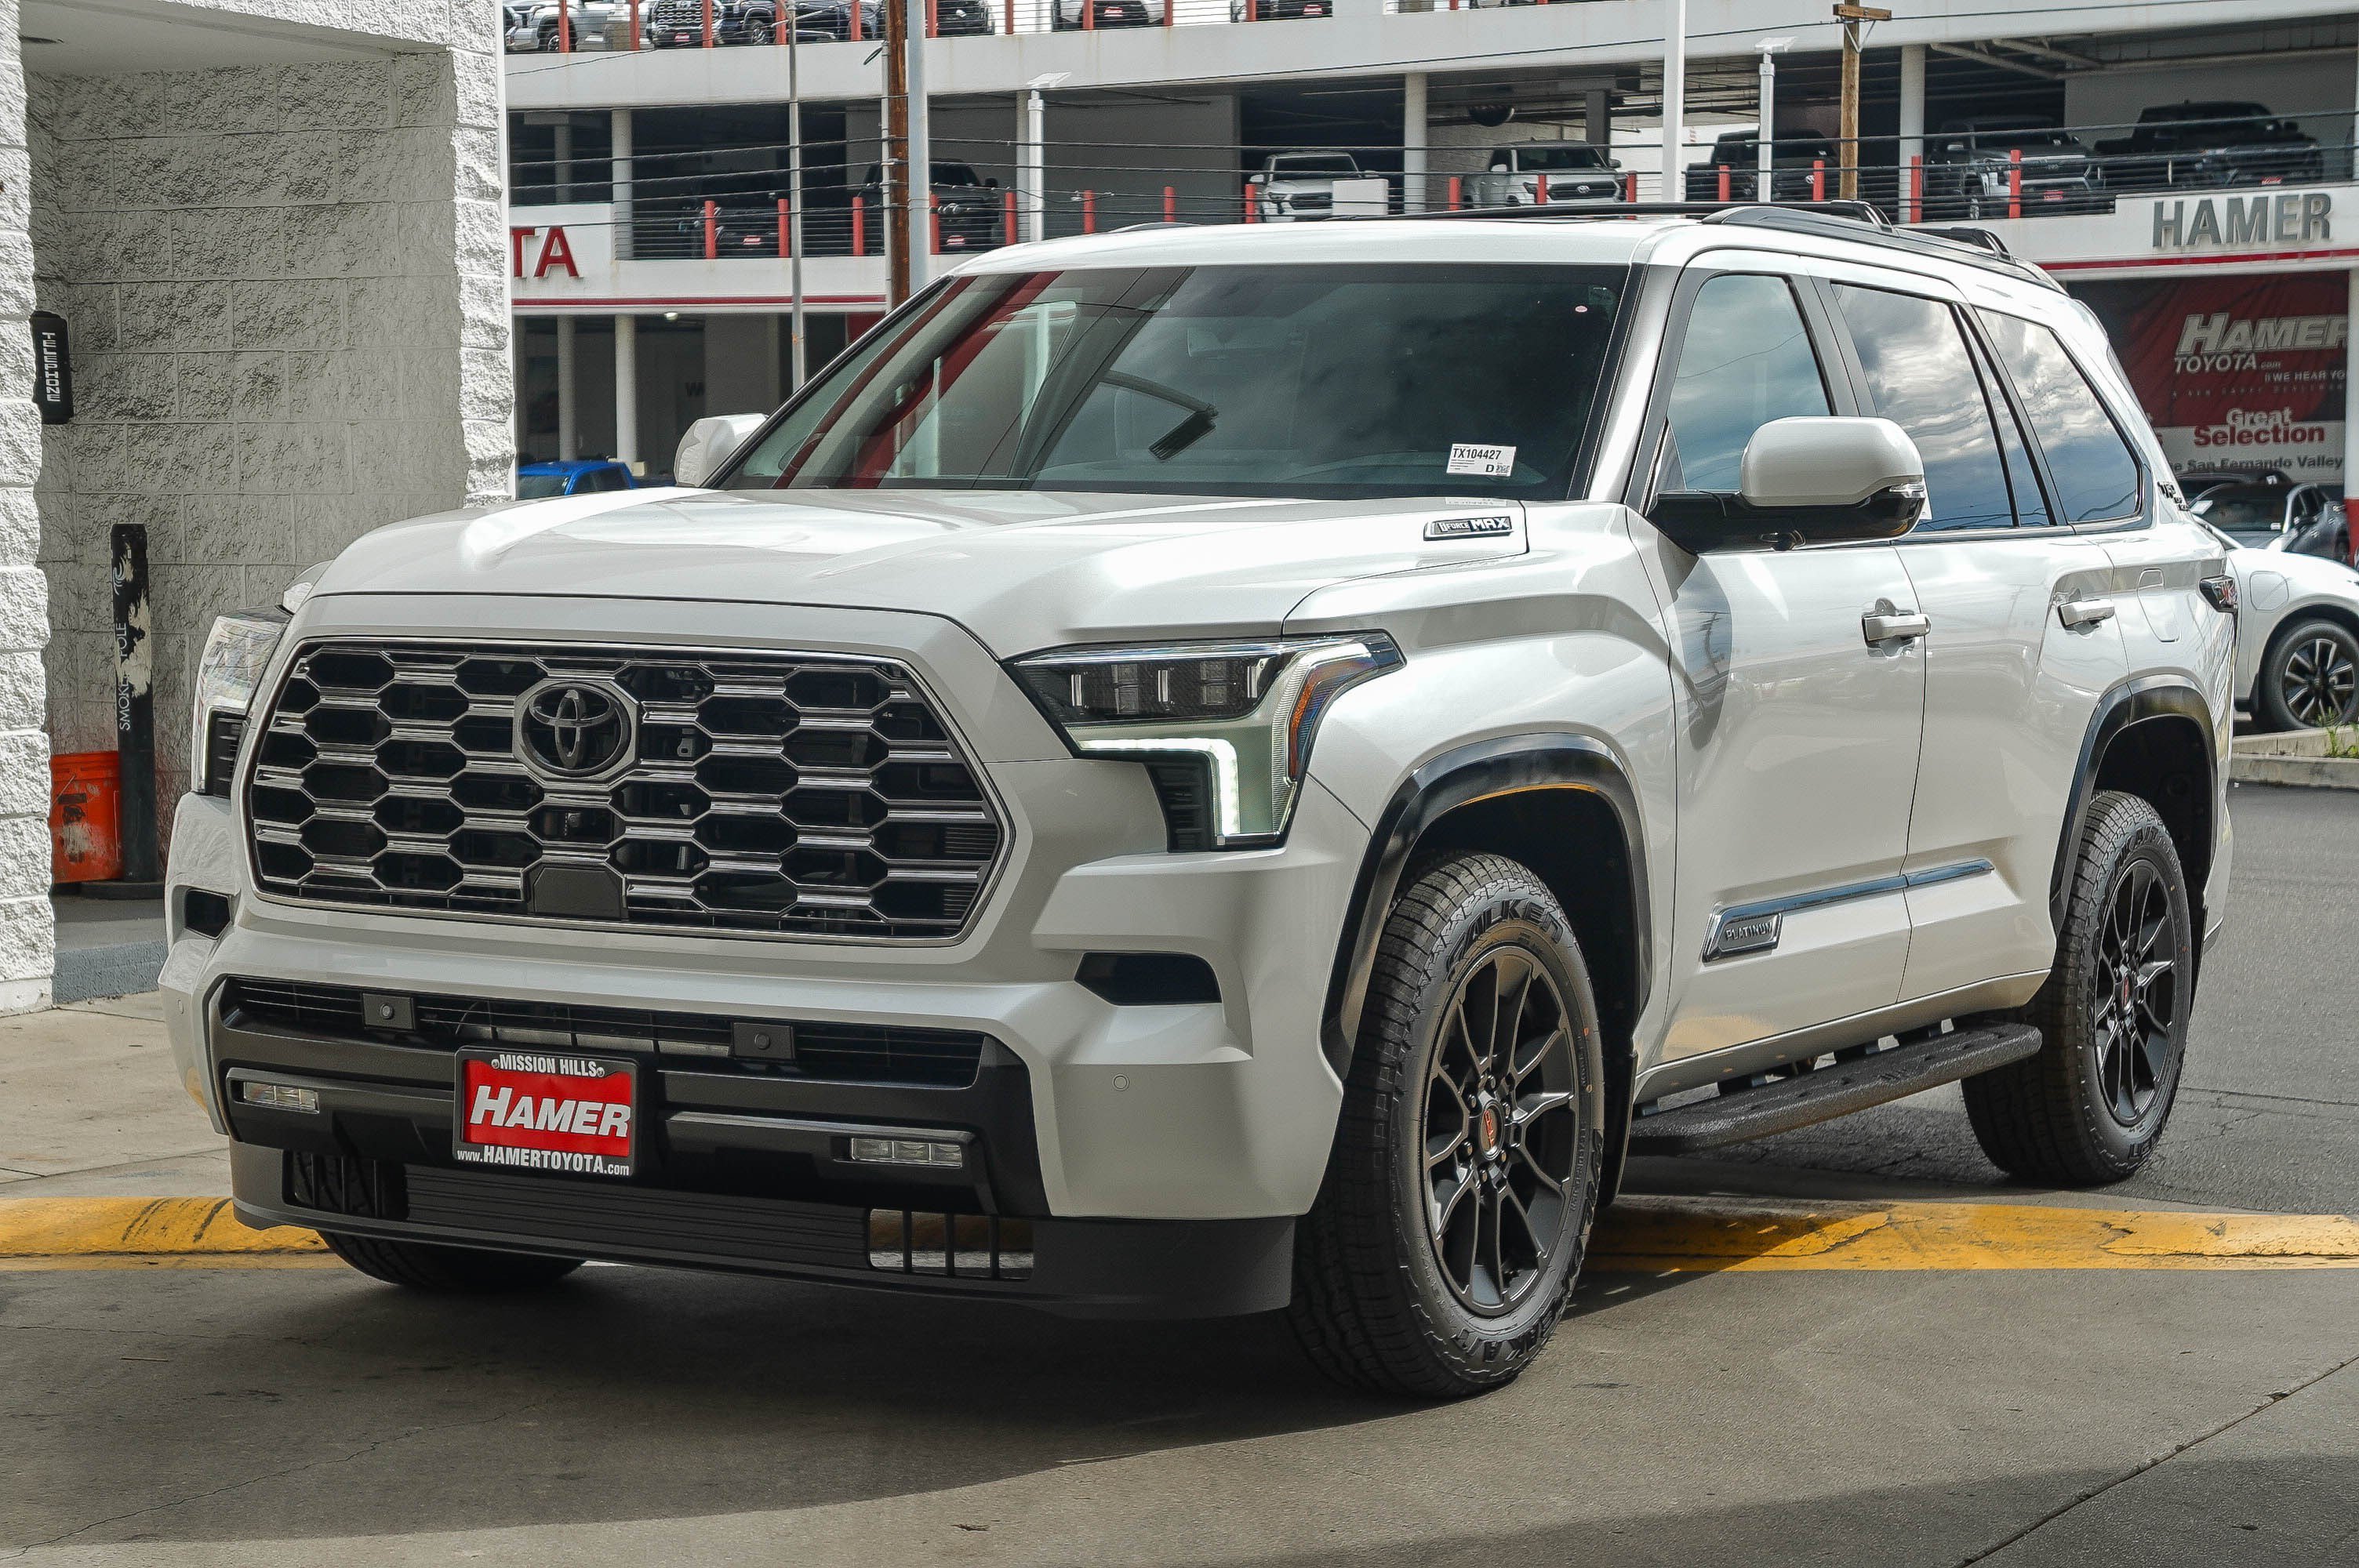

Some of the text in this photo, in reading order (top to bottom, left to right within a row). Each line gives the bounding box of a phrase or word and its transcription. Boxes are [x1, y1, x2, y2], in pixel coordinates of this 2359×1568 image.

[2152, 193, 2332, 249] HAMER
[42, 332, 60, 402] TELEPHONE
[2175, 352, 2257, 374] TOYOTA
[2330, 369, 2346, 380] YO
[2226, 406, 2293, 427] Great
[2194, 424, 2325, 446] Selection
[1453, 448, 1502, 460] TX104427
[2187, 459, 2215, 470] San
[2221, 456, 2292, 470] Fernando
[2297, 455, 2343, 470] Valley
[1470, 517, 1510, 532] MAX
[1725, 921, 1772, 941] PLATINUM
[499, 1054, 598, 1078] MISSION HILLS
[469, 1085, 631, 1138] HAMER
[456, 1145, 630, 1176] www.HAMERTOYOTA.com
